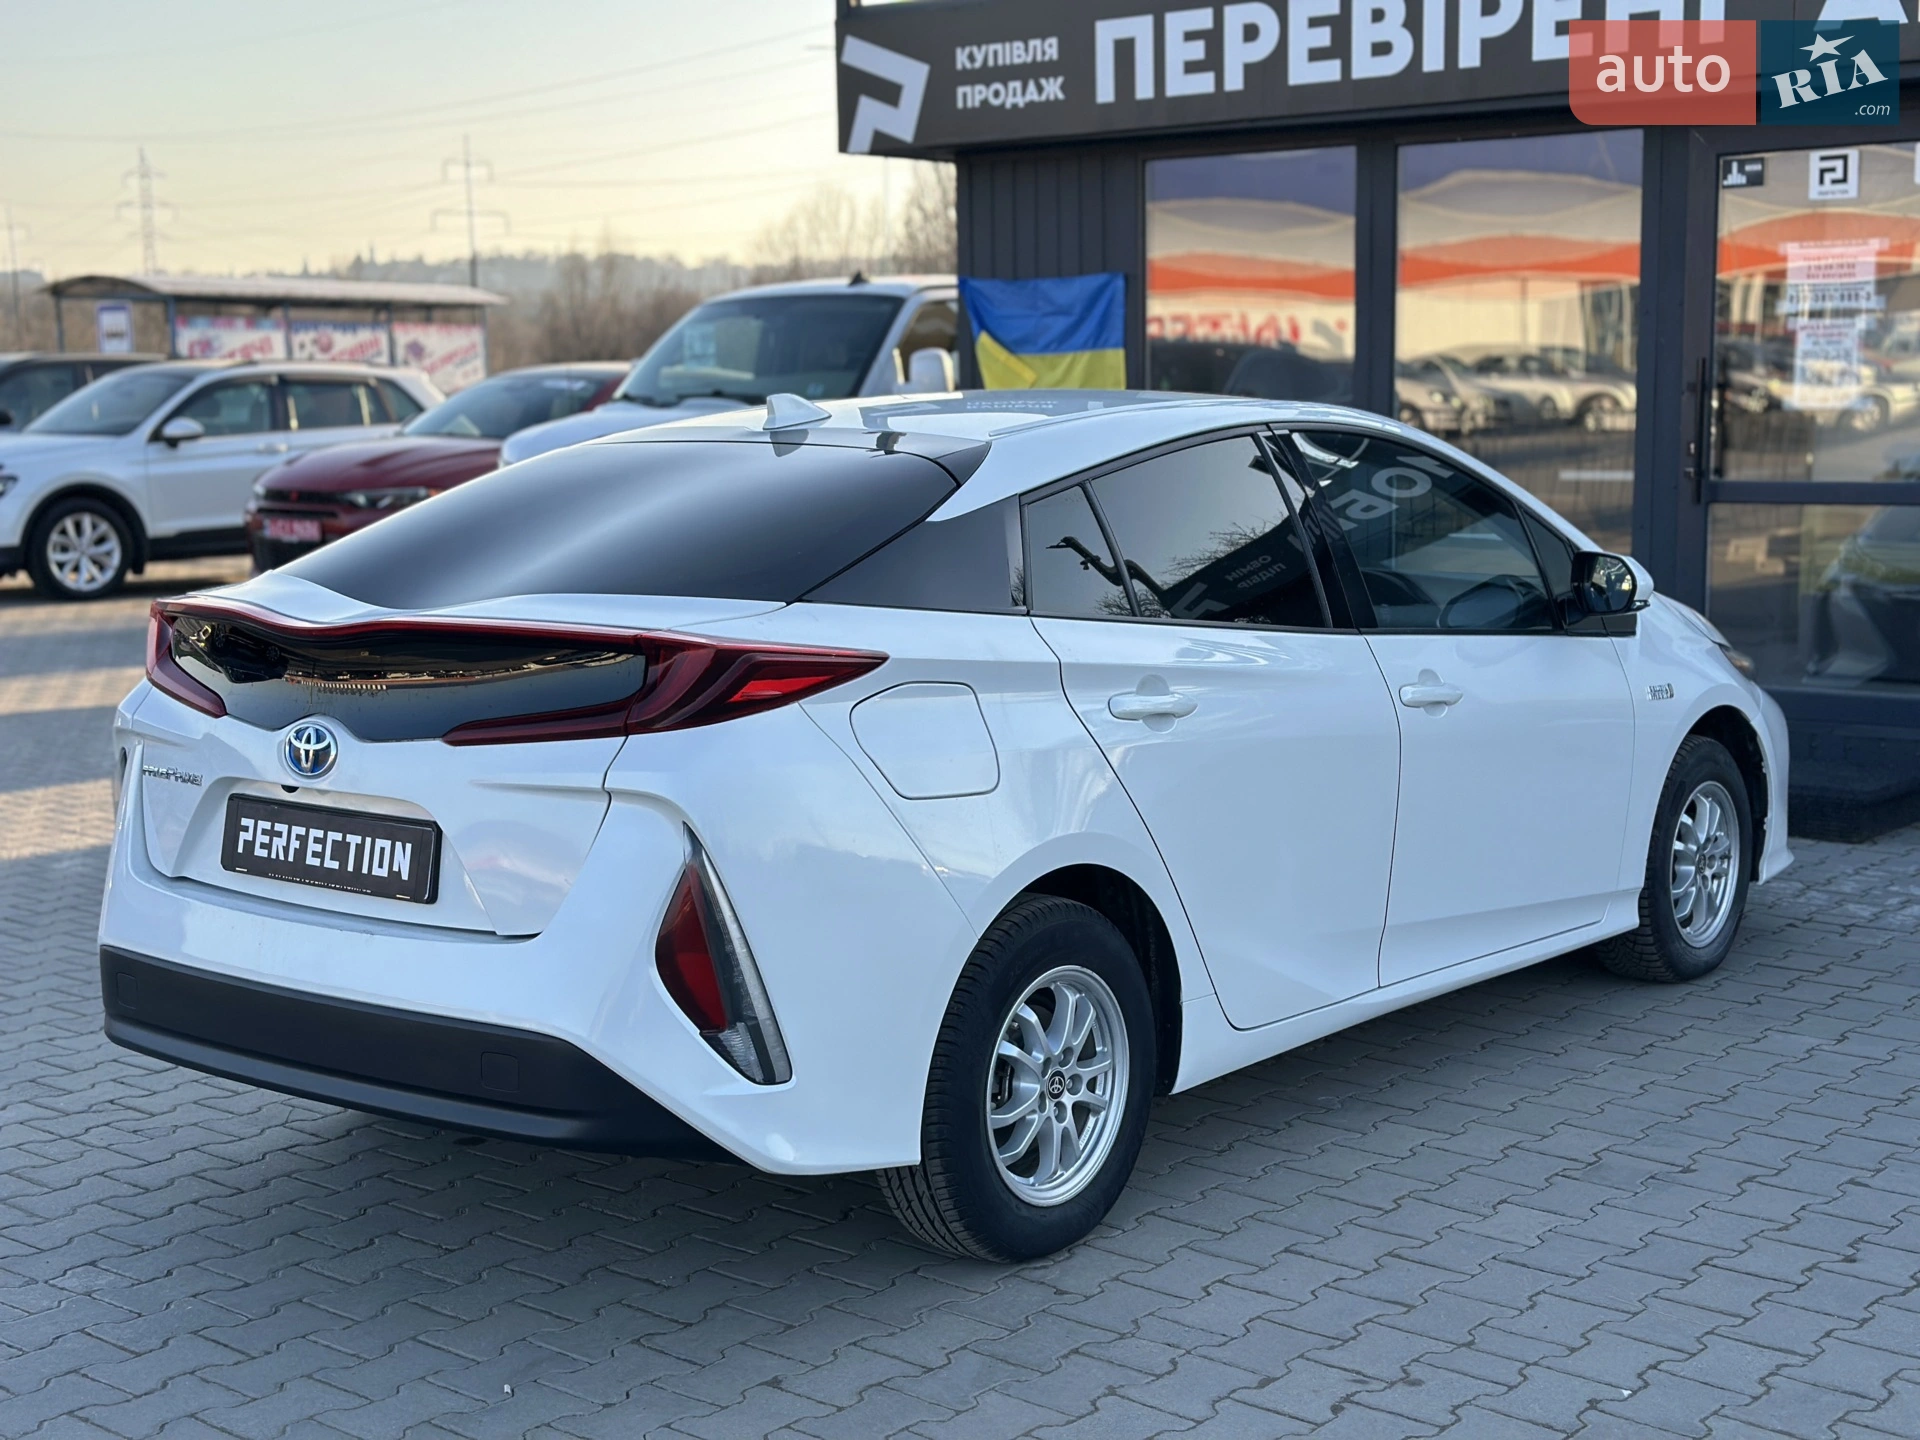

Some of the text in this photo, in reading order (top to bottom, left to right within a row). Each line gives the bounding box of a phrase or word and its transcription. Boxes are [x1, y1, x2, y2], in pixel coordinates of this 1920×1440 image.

[955, 37, 1059, 70] КУПІВЛЯ
[955, 76, 1065, 109] ПРОДАЖ
[237, 817, 413, 881] PERFECTION
